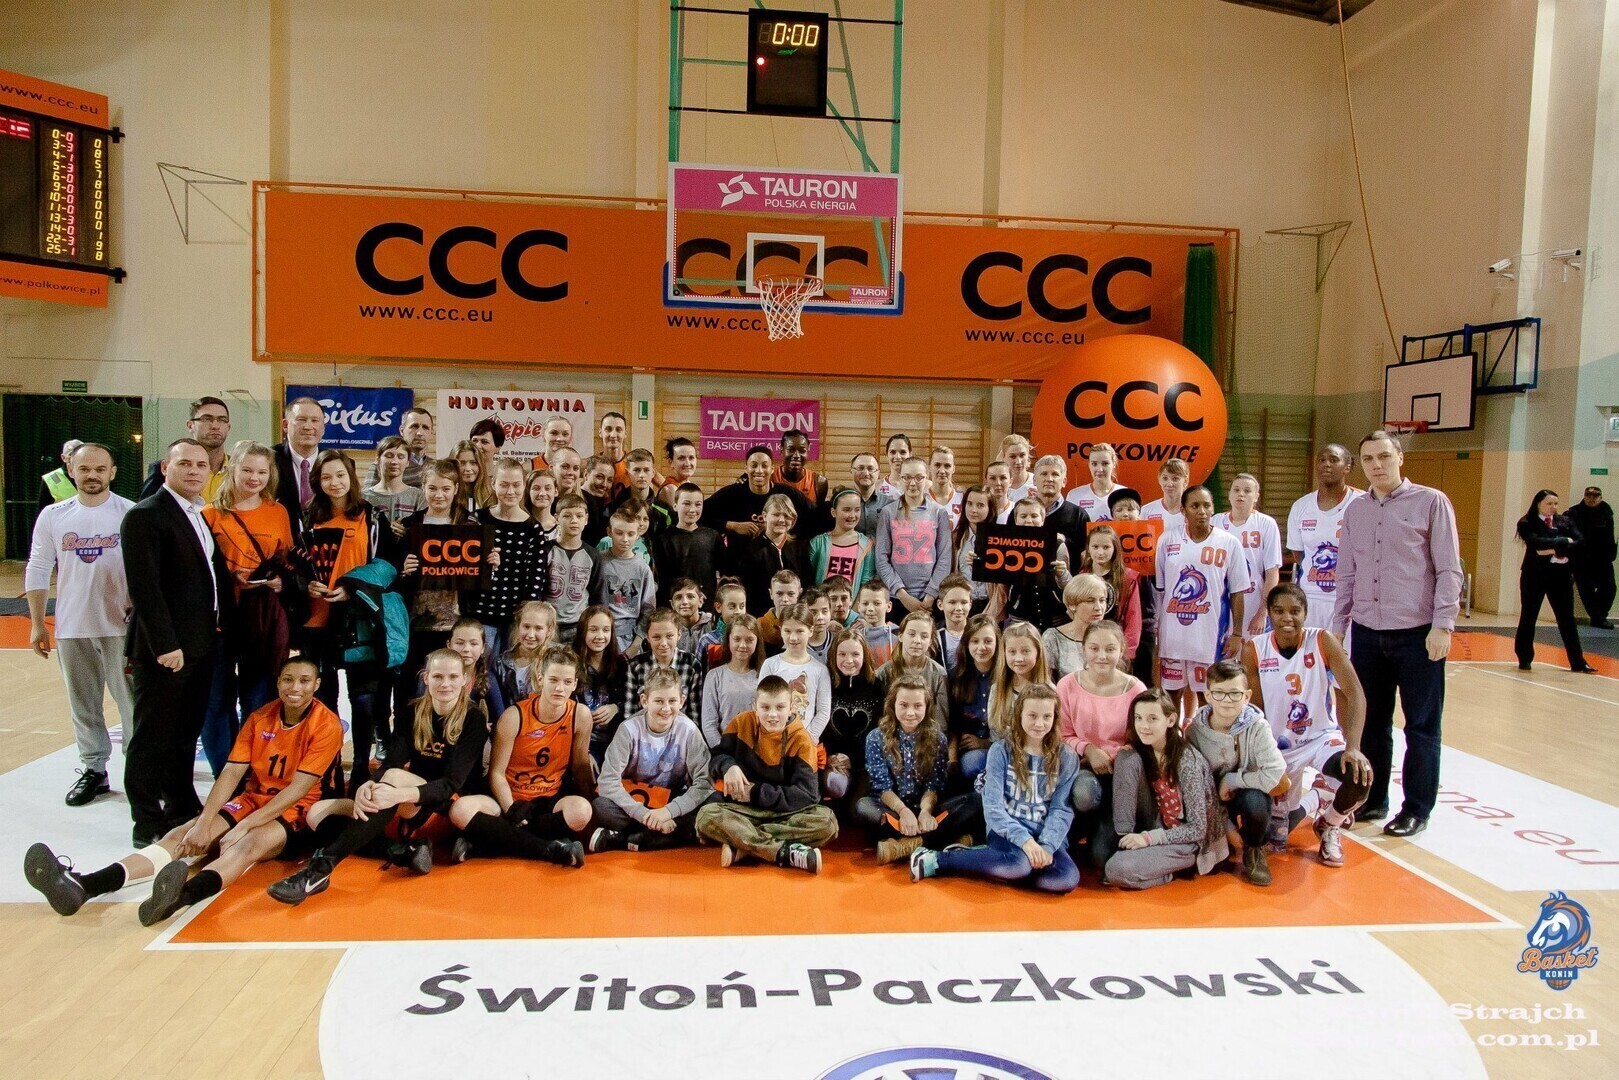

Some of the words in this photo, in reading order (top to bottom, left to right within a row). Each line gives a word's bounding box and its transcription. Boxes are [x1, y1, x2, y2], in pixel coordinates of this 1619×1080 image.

[772, 23, 819, 46] 0:00
[0, 84, 98, 114] www.ccc.eu
[94, 139, 102, 149] 0
[94, 149, 102, 159] 8
[95, 160, 101, 169] 5
[96, 170, 102, 179] 7
[95, 180, 102, 190] 8
[759, 177, 858, 199] TAURON
[95, 190, 102, 199] 0
[95, 200, 102, 210] 0
[764, 198, 807, 209] POLSKA
[810, 200, 857, 211] ENERGIA
[95, 210, 102, 220] 0
[95, 221, 102, 230] 0
[98, 231, 103, 240] 1
[96, 241, 103, 251] 9
[95, 251, 103, 261] 8
[355, 222, 569, 302] CCC
[0, 278, 100, 296] ww.polkowice.pl
[851, 287, 888, 297] TAURON
[961, 251, 1152, 325] CCC
[359, 305, 493, 322] www.ccc.eu
[667, 315, 794, 332] www.ccc.
[965, 329, 1085, 345] www.ccc.eu
[448, 395, 586, 413] HURTOWNIA
[1064, 380, 1205, 432] CCC
[708, 410, 814, 433] TAURON
[706, 440, 747, 451] BASKET
[1067, 442, 1200, 463] POKOWICE
[62, 532, 120, 551] Basket
[893, 527, 934, 564] 52
[987, 536, 1044, 549] POLKOWICE
[1120, 533, 1153, 553] CC
[1241, 530, 1261, 549] 13
[422, 539, 481, 563] CCC
[1200, 546, 1227, 568] 00
[984, 548, 1044, 573] CCC
[422, 566, 480, 576] POLKOWICE
[1166, 597, 1211, 614] Basket
[1285, 673, 1303, 695] 3
[268, 753, 288, 779] 11
[535, 747, 551, 768] 6
[404, 957, 1366, 1016] Świtoń-Paczkowski
